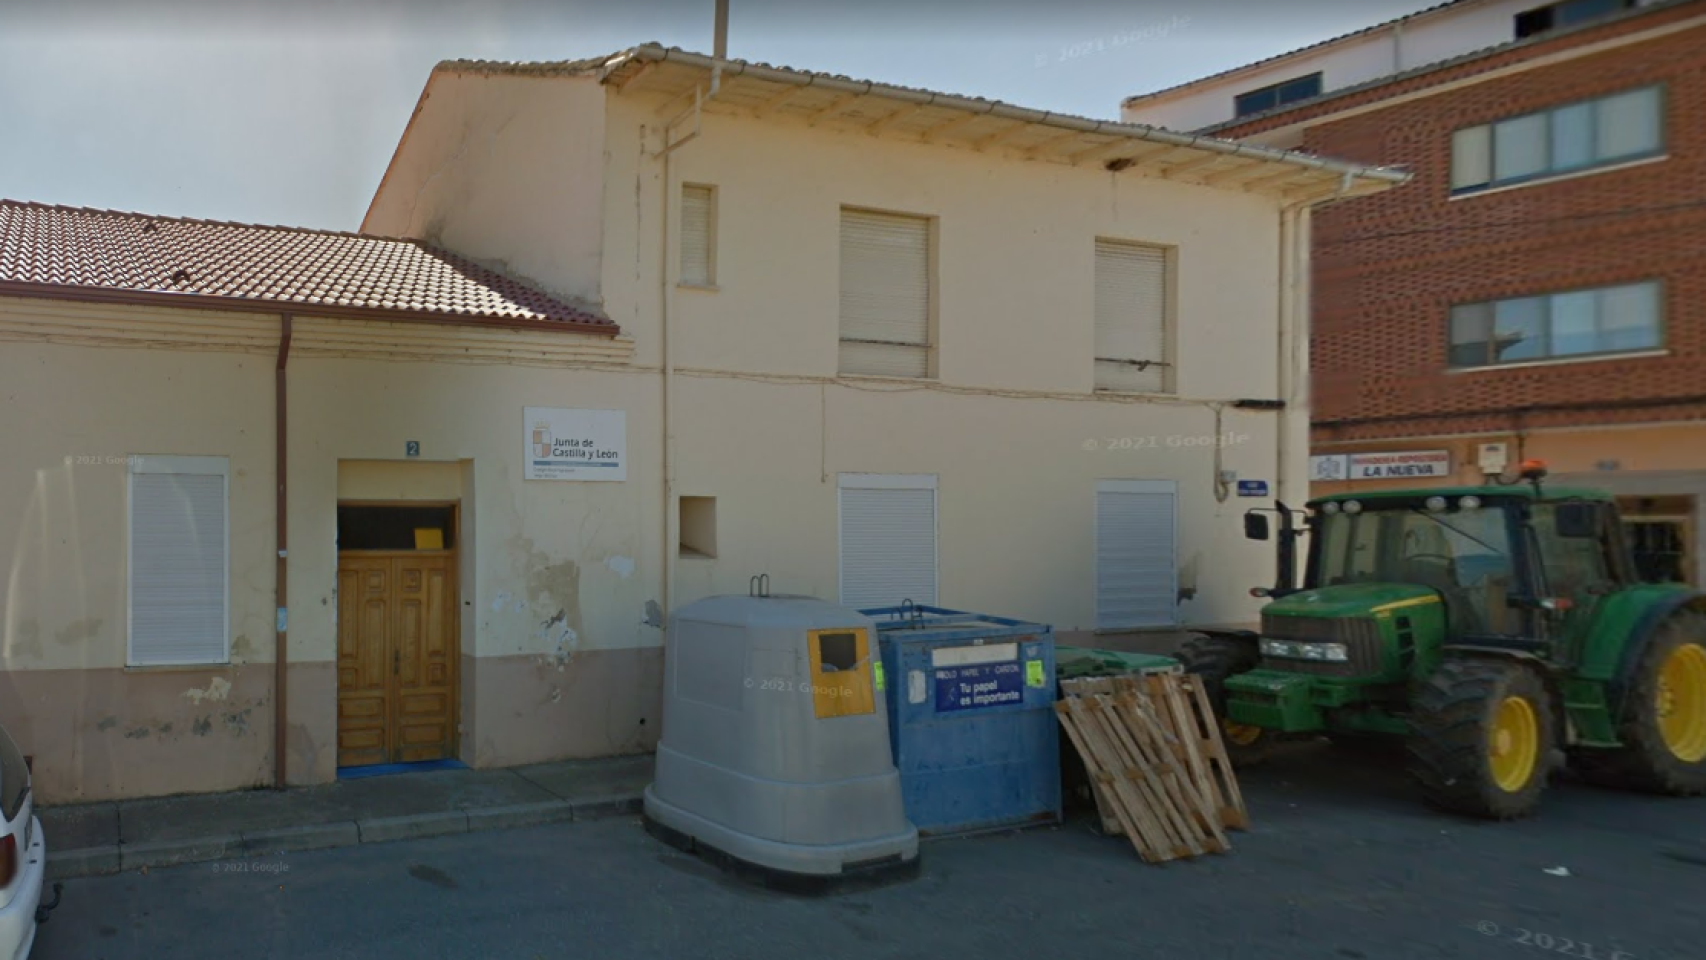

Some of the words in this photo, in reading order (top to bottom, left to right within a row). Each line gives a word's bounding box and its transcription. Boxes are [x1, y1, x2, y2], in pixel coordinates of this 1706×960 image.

[409, 442, 417, 454] 2
[553, 438, 579, 448] Junta
[582, 439, 594, 448] de
[552, 447, 586, 458] Castilla
[588, 451, 595, 460] y
[596, 449, 618, 459] León
[1362, 465, 1382, 477] LA
[1386, 463, 1434, 476] NUEVA
[961, 667, 980, 677] PAPEL
[960, 682, 971, 693] Tu
[974, 680, 998, 693] papel
[960, 696, 972, 706] es
[974, 691, 1020, 705] importante
